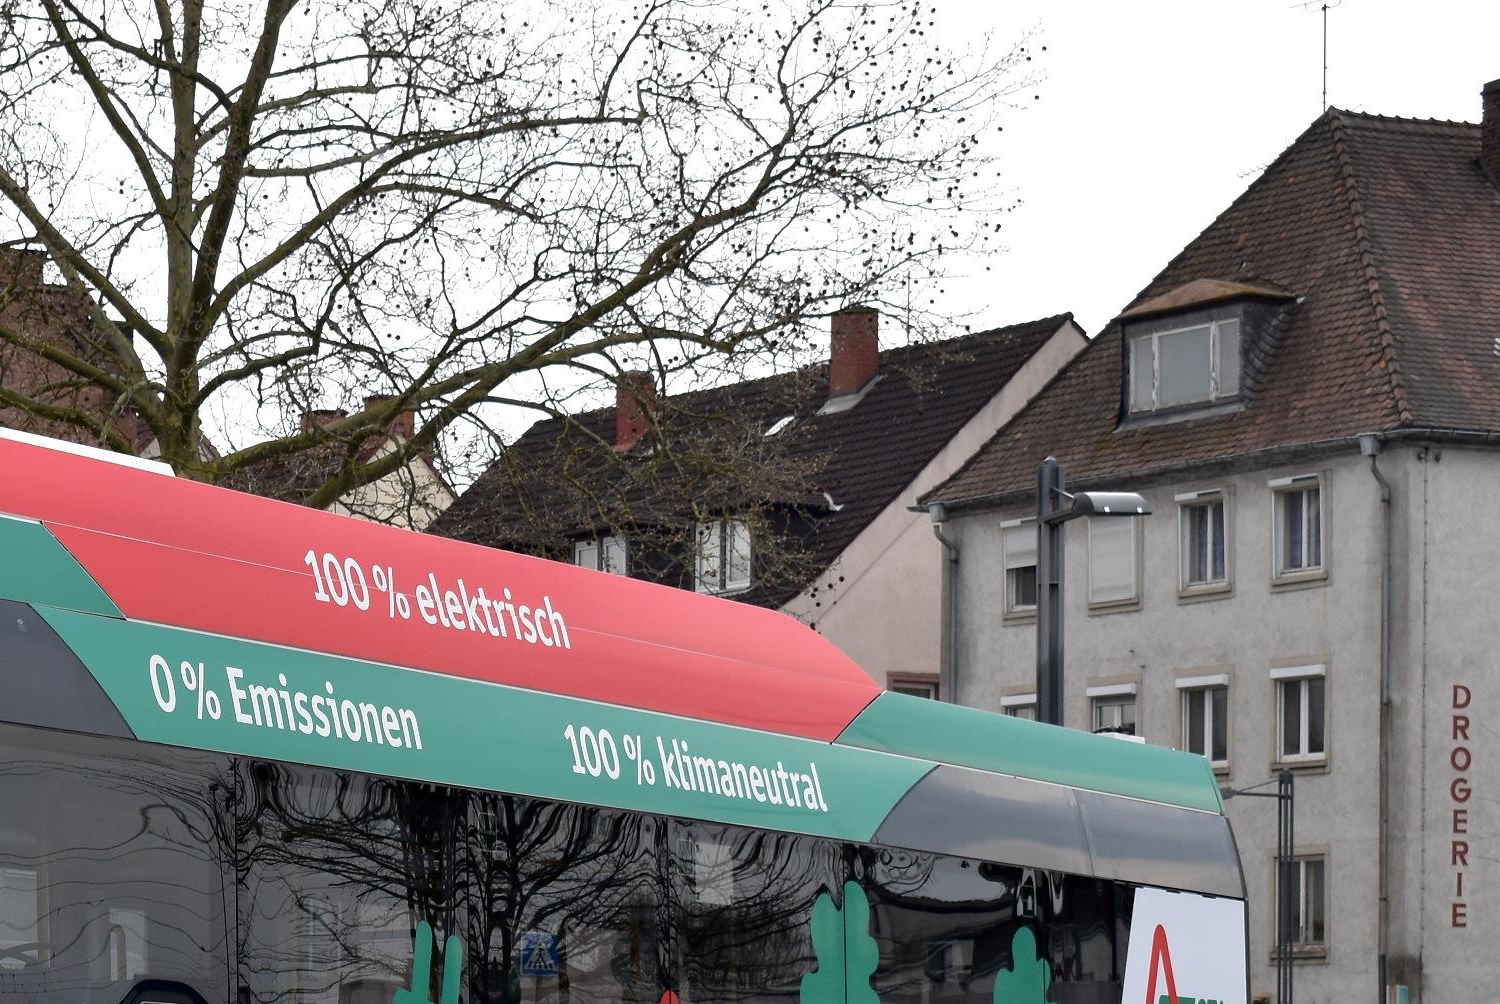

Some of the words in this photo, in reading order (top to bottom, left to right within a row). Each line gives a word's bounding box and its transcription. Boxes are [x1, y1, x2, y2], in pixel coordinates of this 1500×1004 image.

[304, 549, 369, 611] 100
[372, 564, 411, 620] %
[415, 572, 571, 650] elektrisch
[149, 654, 176, 713] 0
[180, 660, 221, 720] %
[225, 666, 423, 750] Emissionen
[563, 724, 620, 780] 100
[623, 734, 656, 785] %
[656, 736, 829, 812] klimaneutral
[1450, 684, 1472, 928] DROGERIE
